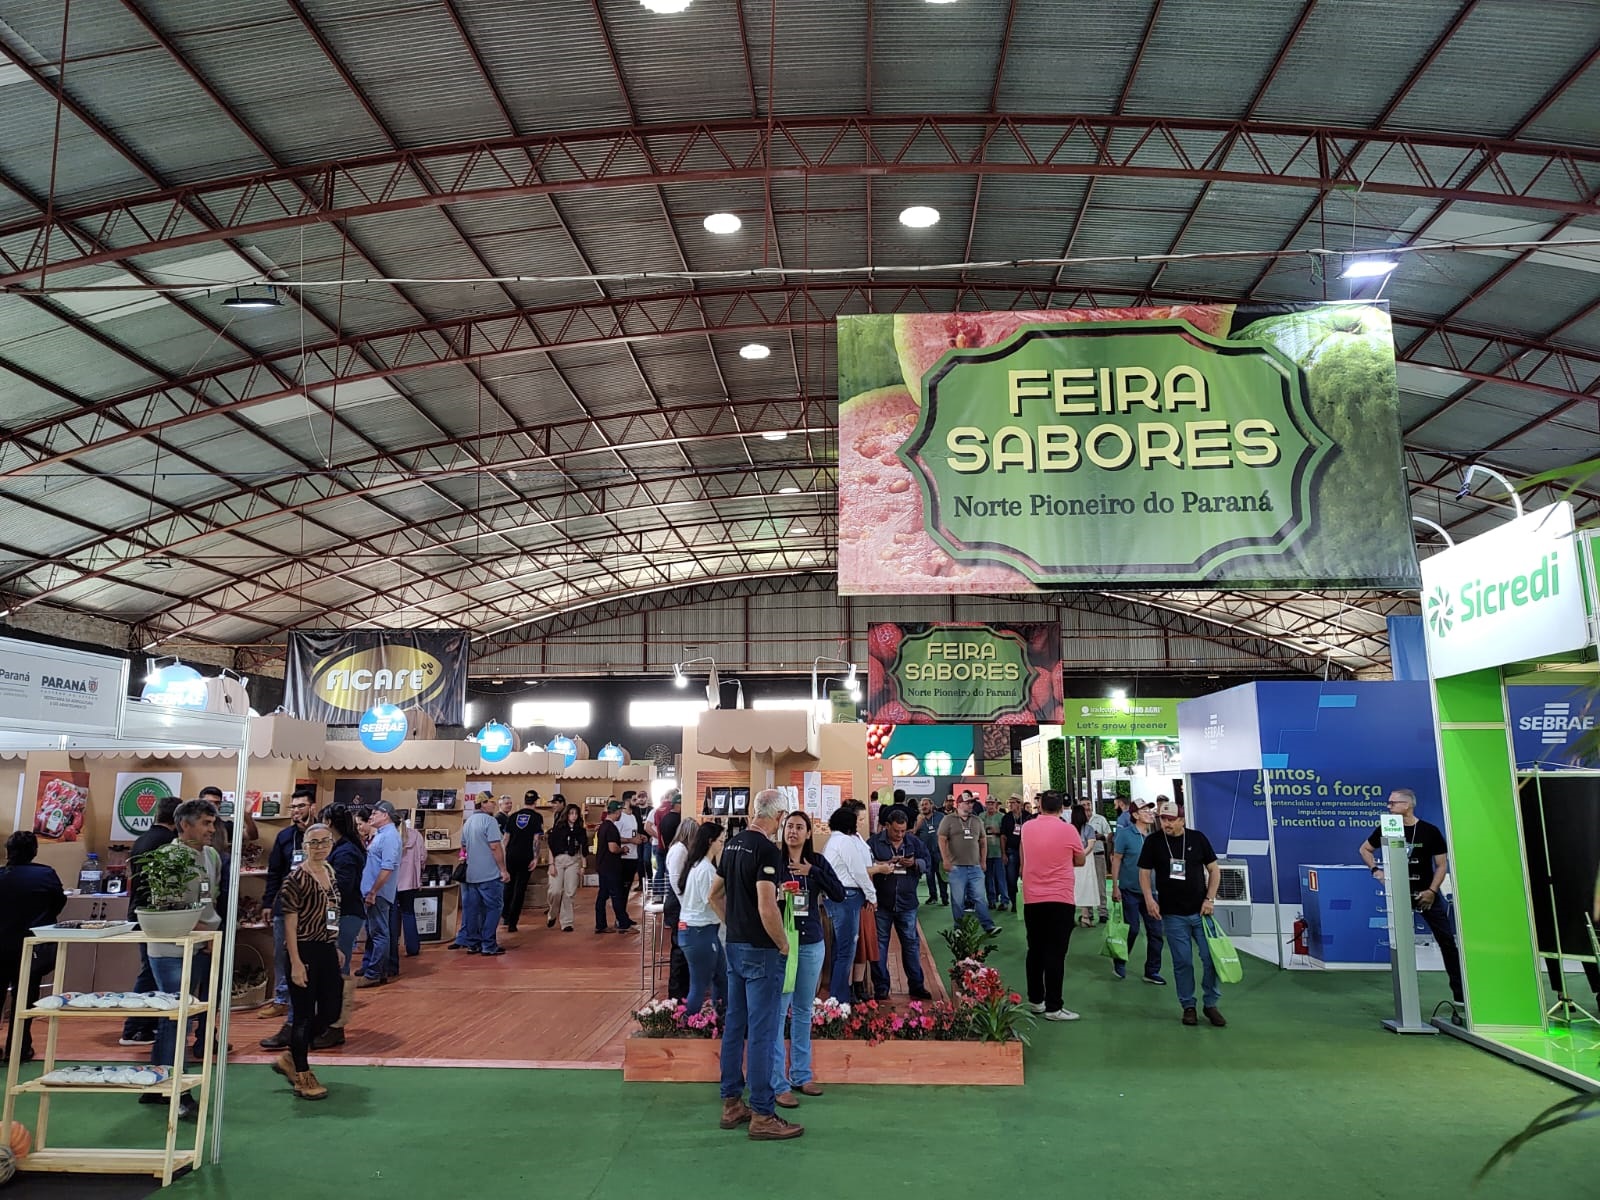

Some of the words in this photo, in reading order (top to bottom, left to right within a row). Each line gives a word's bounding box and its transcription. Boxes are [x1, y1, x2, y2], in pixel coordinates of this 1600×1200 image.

[1007, 365, 1209, 417] FEIRA
[945, 419, 1281, 473] SABORES
[954, 494, 1023, 518] Norte
[1030, 492, 1135, 516] Pioneiro
[1143, 491, 1175, 514] do
[1181, 489, 1274, 513] Paraná
[1460, 552, 1560, 622] Sicredi
[927, 642, 997, 661] FEIRA
[0, 668, 30, 682] Paraná
[905, 663, 1020, 681] SABORES
[41, 675, 87, 693] PARANÁ
[908, 687, 932, 697] Norte
[933, 687, 971, 697] Pioneiro
[973, 687, 984, 697] do
[986, 687, 1017, 697] Paraná
[361, 722, 405, 733] SEBRAE
[1102, 723, 1127, 731] grow
[1130, 723, 1167, 731] greener
[1519, 715, 1594, 731] SEBRAE
[1253, 784, 1312, 796] somos
[1317, 784, 1328, 796] a
[1334, 780, 1382, 800] força
[1271, 799, 1314, 807] ontencializa
[1281, 816, 1335, 827] incentiva
[1338, 819, 1346, 827] a
